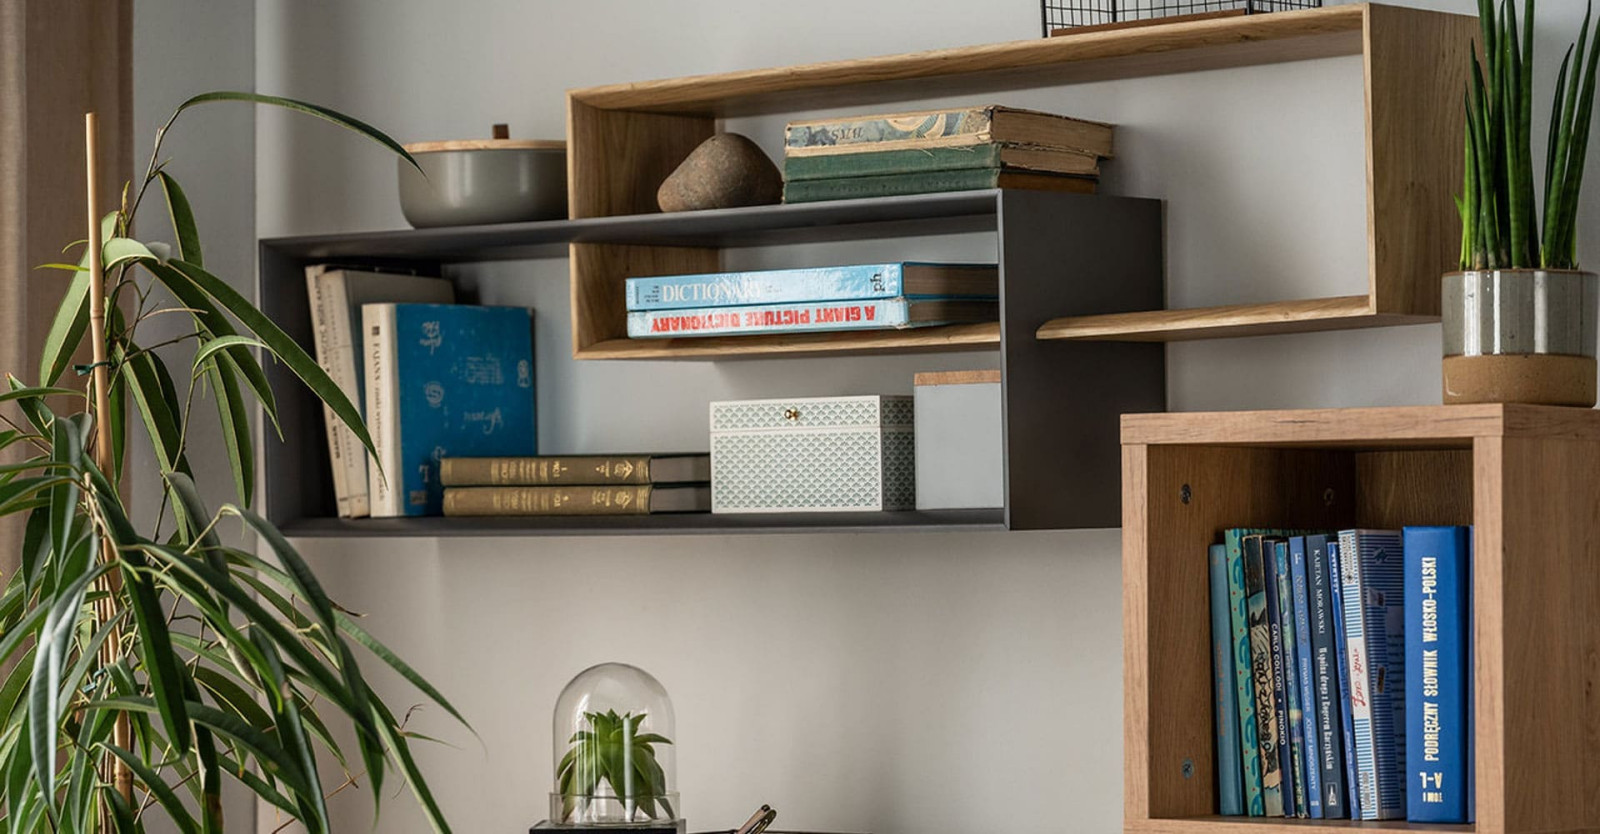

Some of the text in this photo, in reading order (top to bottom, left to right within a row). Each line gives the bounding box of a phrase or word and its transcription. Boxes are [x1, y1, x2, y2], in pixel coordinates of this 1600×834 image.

[662, 281, 762, 303] DICTIONARY
[869, 273, 886, 292] ph
[650, 306, 876, 333] A GIANT PICTURE DICTIONARY
[1313, 549, 1326, 634] KAJETAN MORAWSKI
[1421, 556, 1441, 761] PODRĘCZNY SŁOWNIK WŁOSKO-POLSKI
[1271, 623, 1286, 745] CARLO COLLODI PINOKIO
[1419, 772, 1442, 789] A-L
